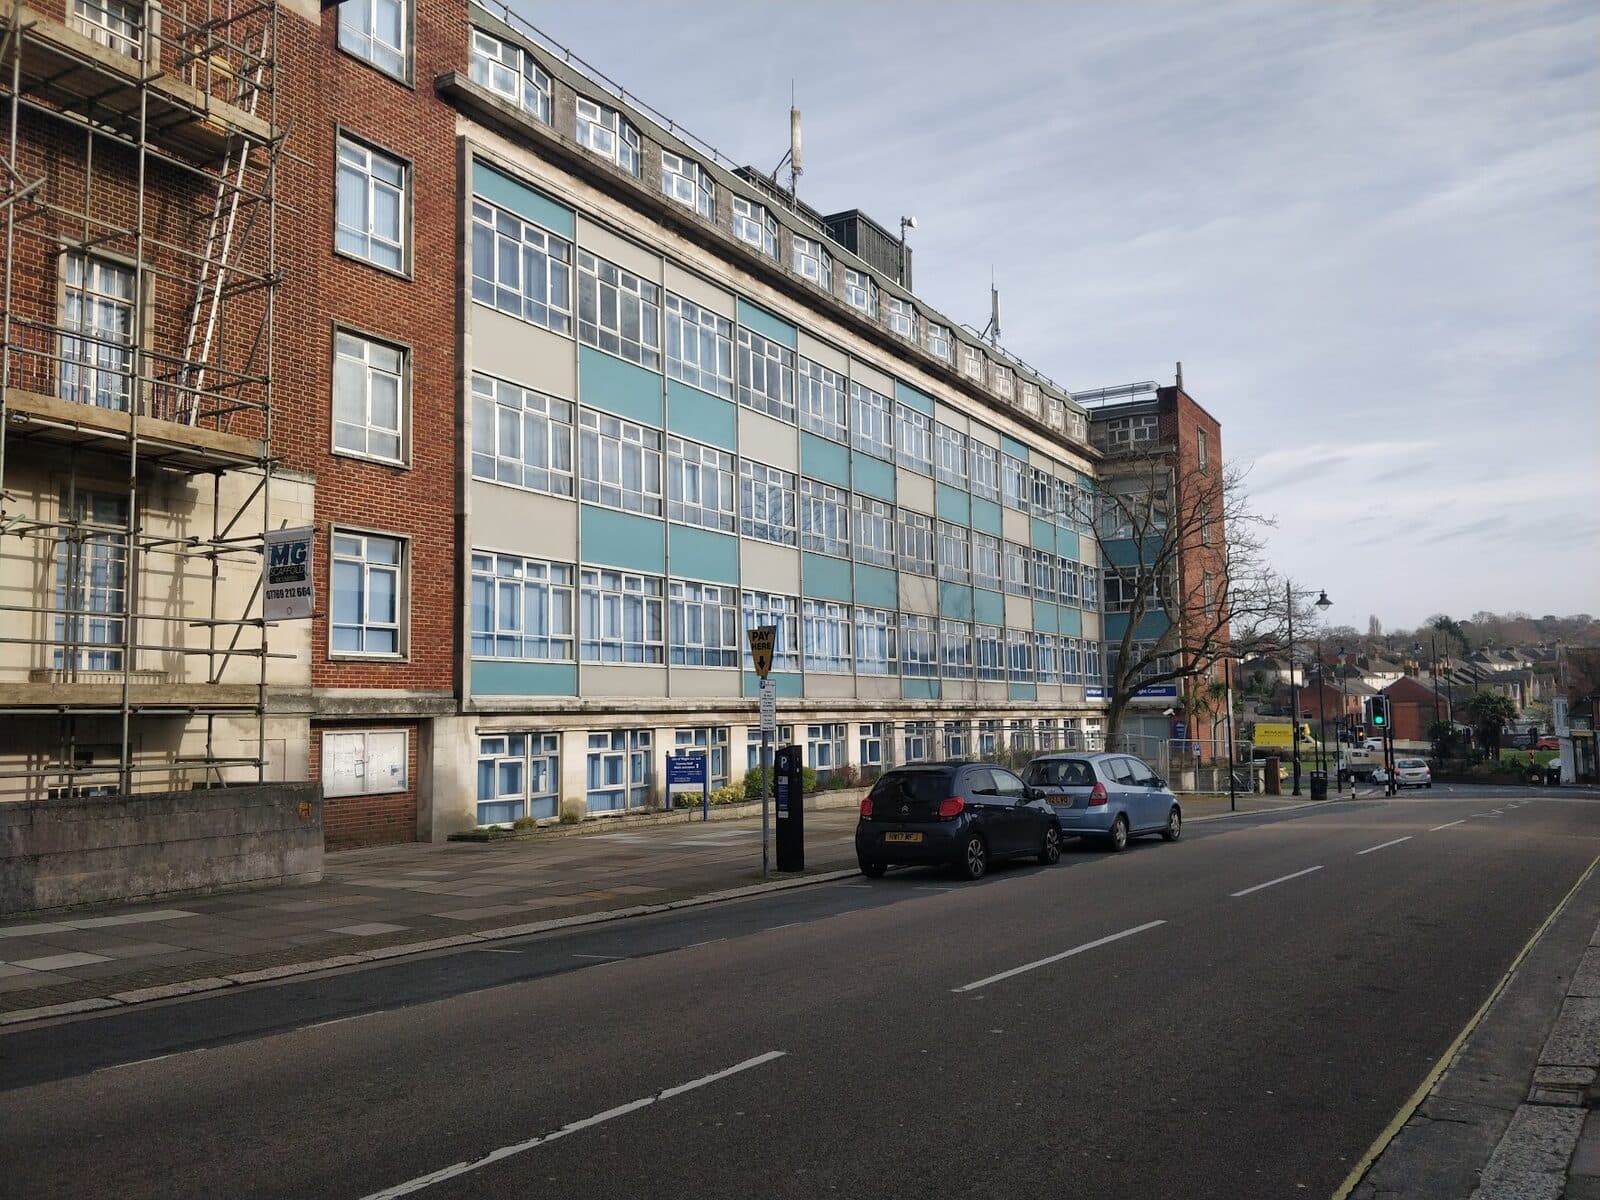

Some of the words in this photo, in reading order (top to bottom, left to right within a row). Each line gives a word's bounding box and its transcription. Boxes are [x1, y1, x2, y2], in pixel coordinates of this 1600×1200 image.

[271, 542, 306, 566] MG
[752, 631, 770, 641] PAY
[751, 642, 771, 650] HERE
[781, 756, 788, 769] P
